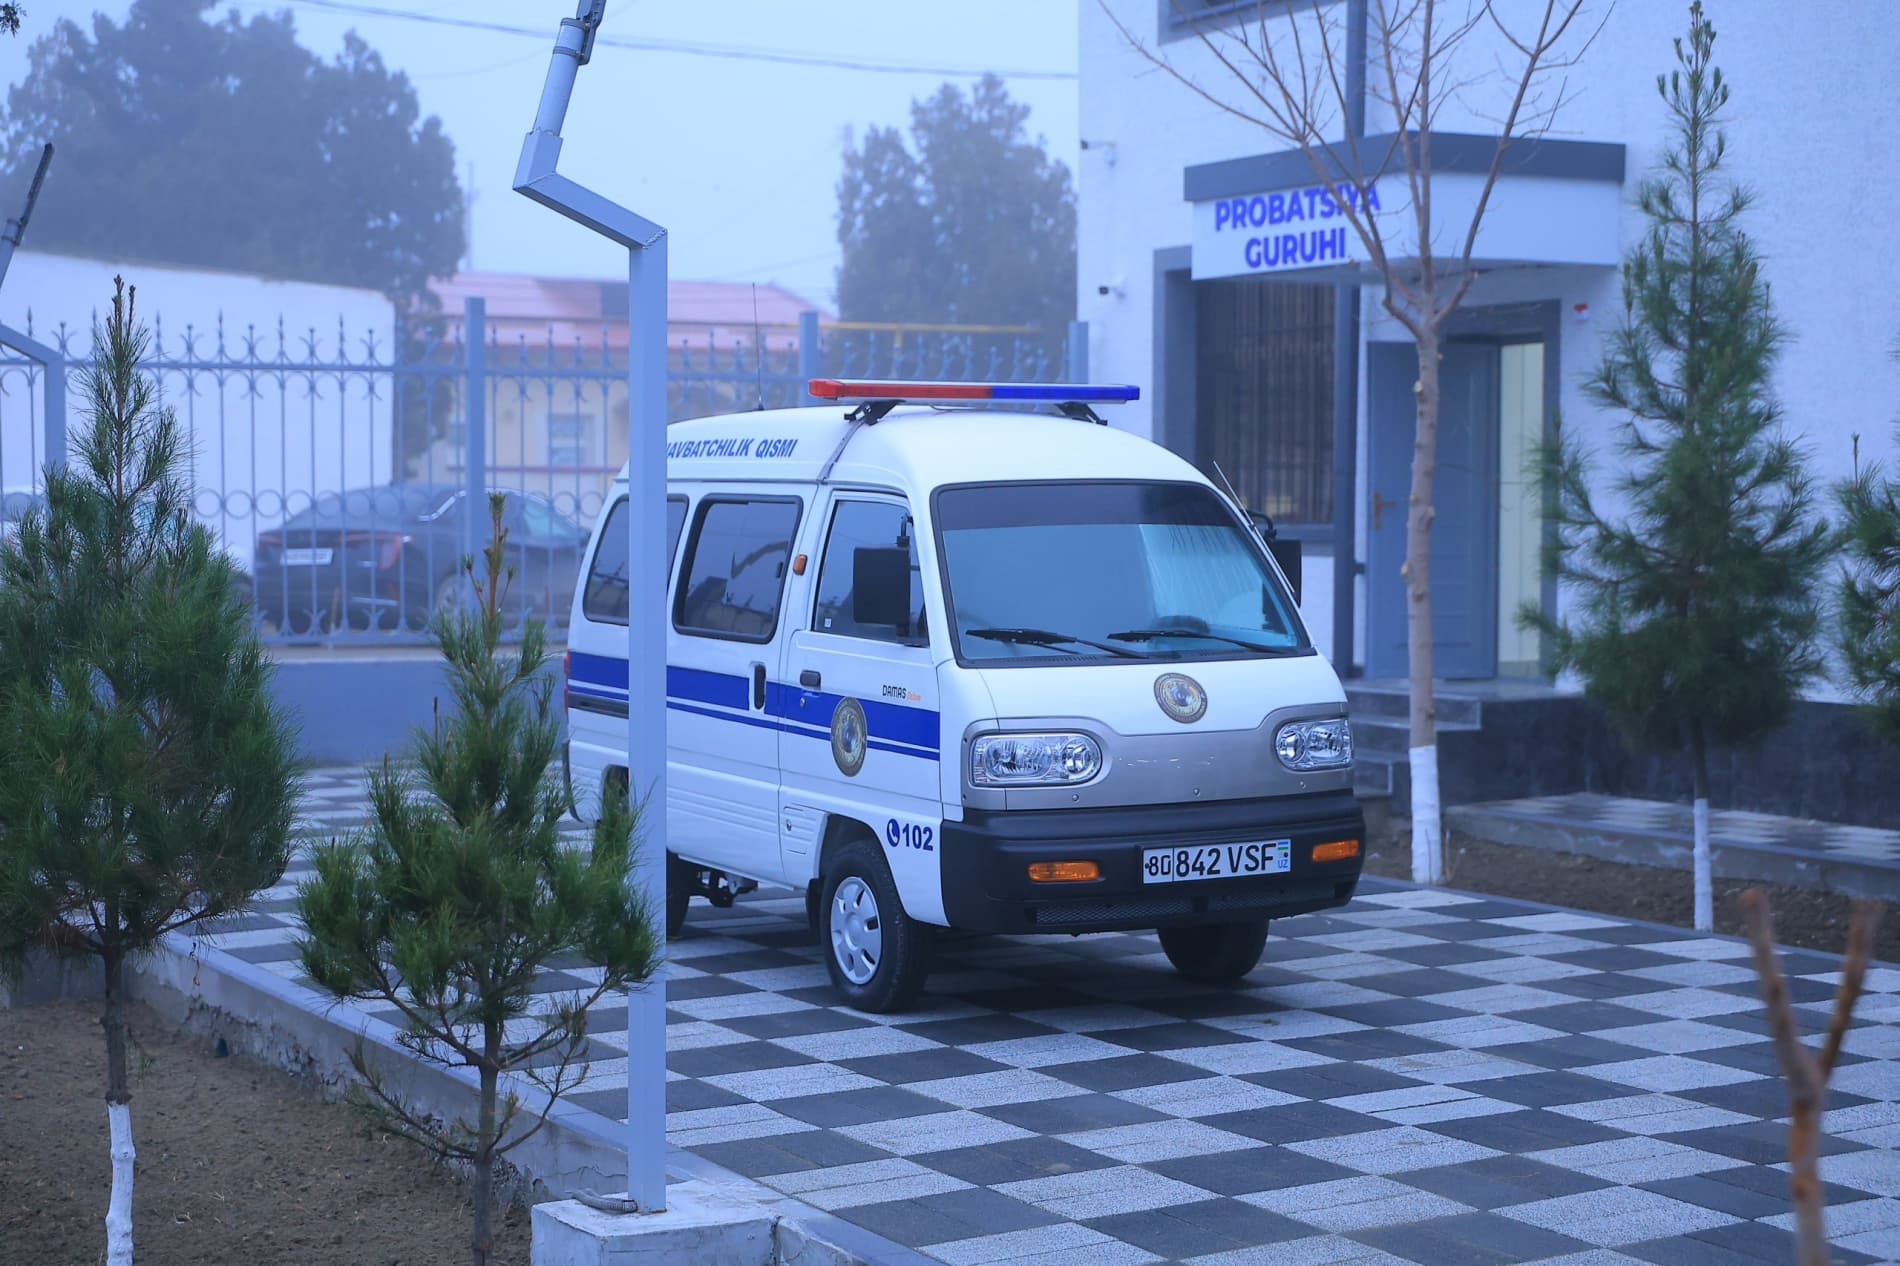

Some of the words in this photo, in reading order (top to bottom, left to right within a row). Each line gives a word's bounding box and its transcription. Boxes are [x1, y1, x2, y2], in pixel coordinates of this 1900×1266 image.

[1214, 180, 1381, 232] PROBATSIYA
[1245, 227, 1346, 268] GURUHI
[755, 438, 799, 458] QISMI
[882, 684, 907, 699] DAMAS
[902, 823, 934, 851] 102
[1175, 848, 1221, 877] 842
[1227, 842, 1277, 873] VSF
[1277, 859, 1289, 868] UZ
